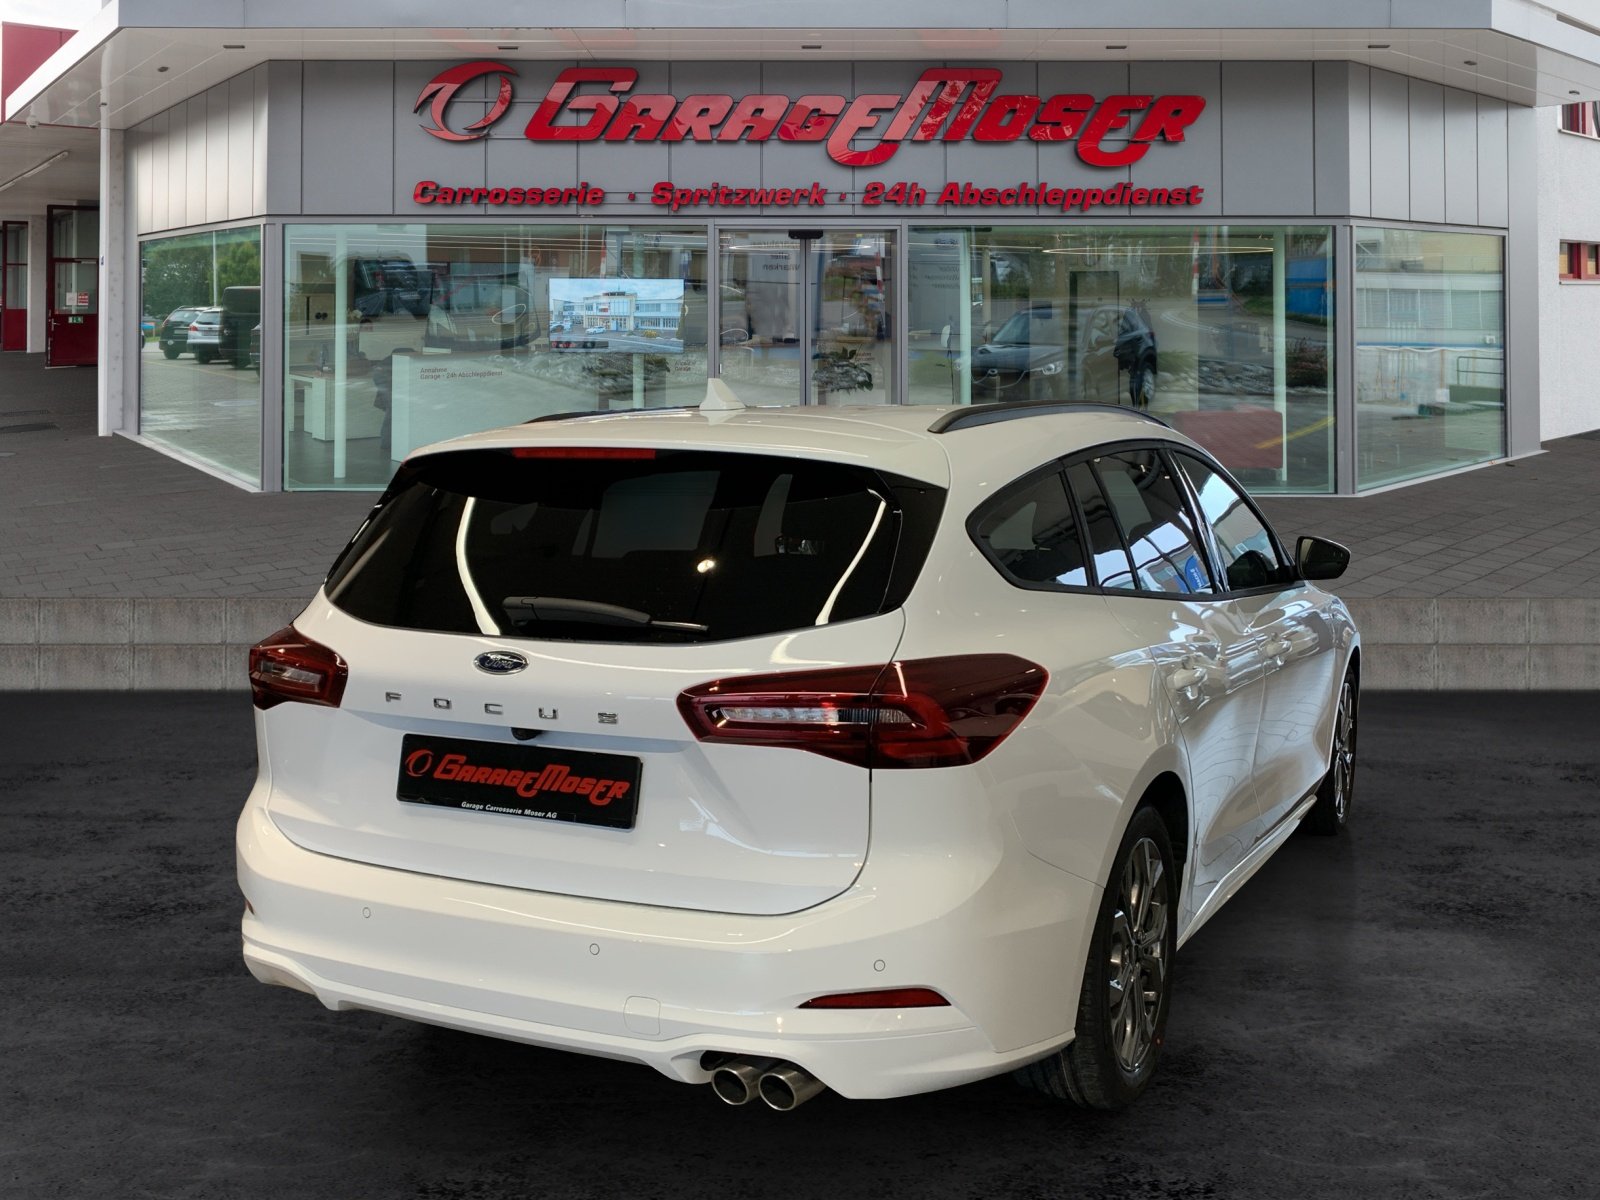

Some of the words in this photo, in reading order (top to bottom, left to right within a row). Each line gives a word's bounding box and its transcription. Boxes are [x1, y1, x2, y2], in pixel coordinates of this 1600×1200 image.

[413, 180, 605, 205] Carrosserie
[651, 182, 828, 211] Spritzwerk
[862, 182, 927, 206] 24h
[936, 182, 1204, 211] Abschleppdienst
[385, 692, 619, 724] FOCUS
[461, 801, 484, 811] Garage
[486, 804, 522, 815] Carrosserie
[524, 808, 546, 818] Moser
[546, 811, 558, 819] AG
